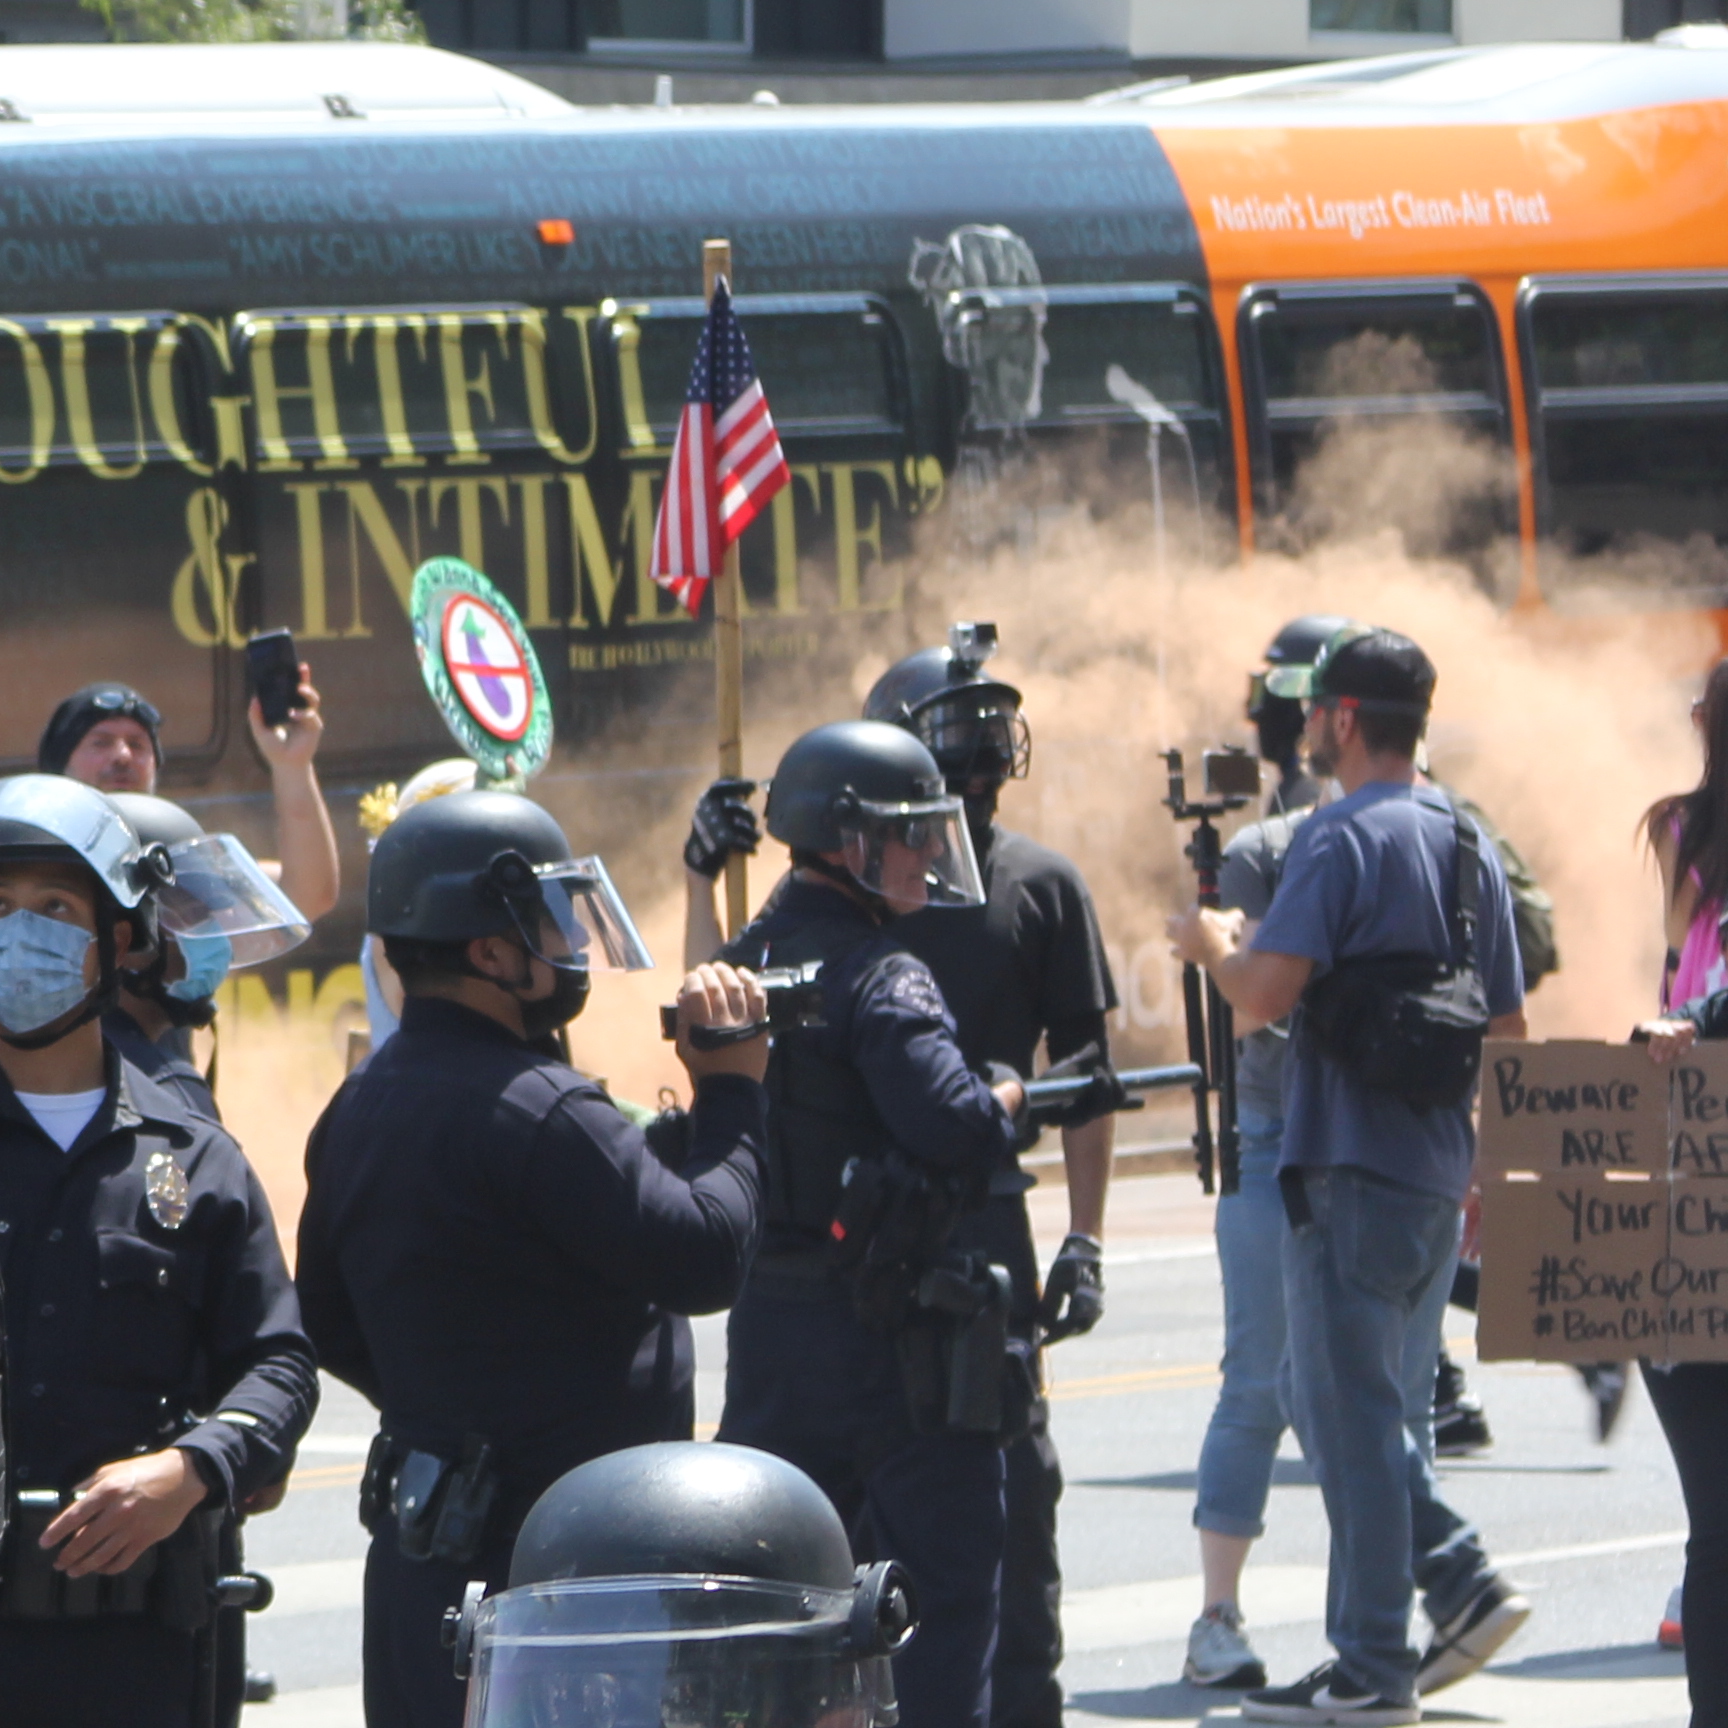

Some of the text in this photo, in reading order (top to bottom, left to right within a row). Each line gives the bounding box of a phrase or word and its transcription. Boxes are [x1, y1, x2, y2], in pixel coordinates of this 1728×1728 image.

[1210, 188, 1550, 240] Nation's Largest Clean-Air Fleet
[171, 485, 256, 646] &
[282, 453, 943, 642] INTIMTE”
[1494, 1056, 1640, 1118] Beware
[1561, 1128, 1638, 1168] ARE
